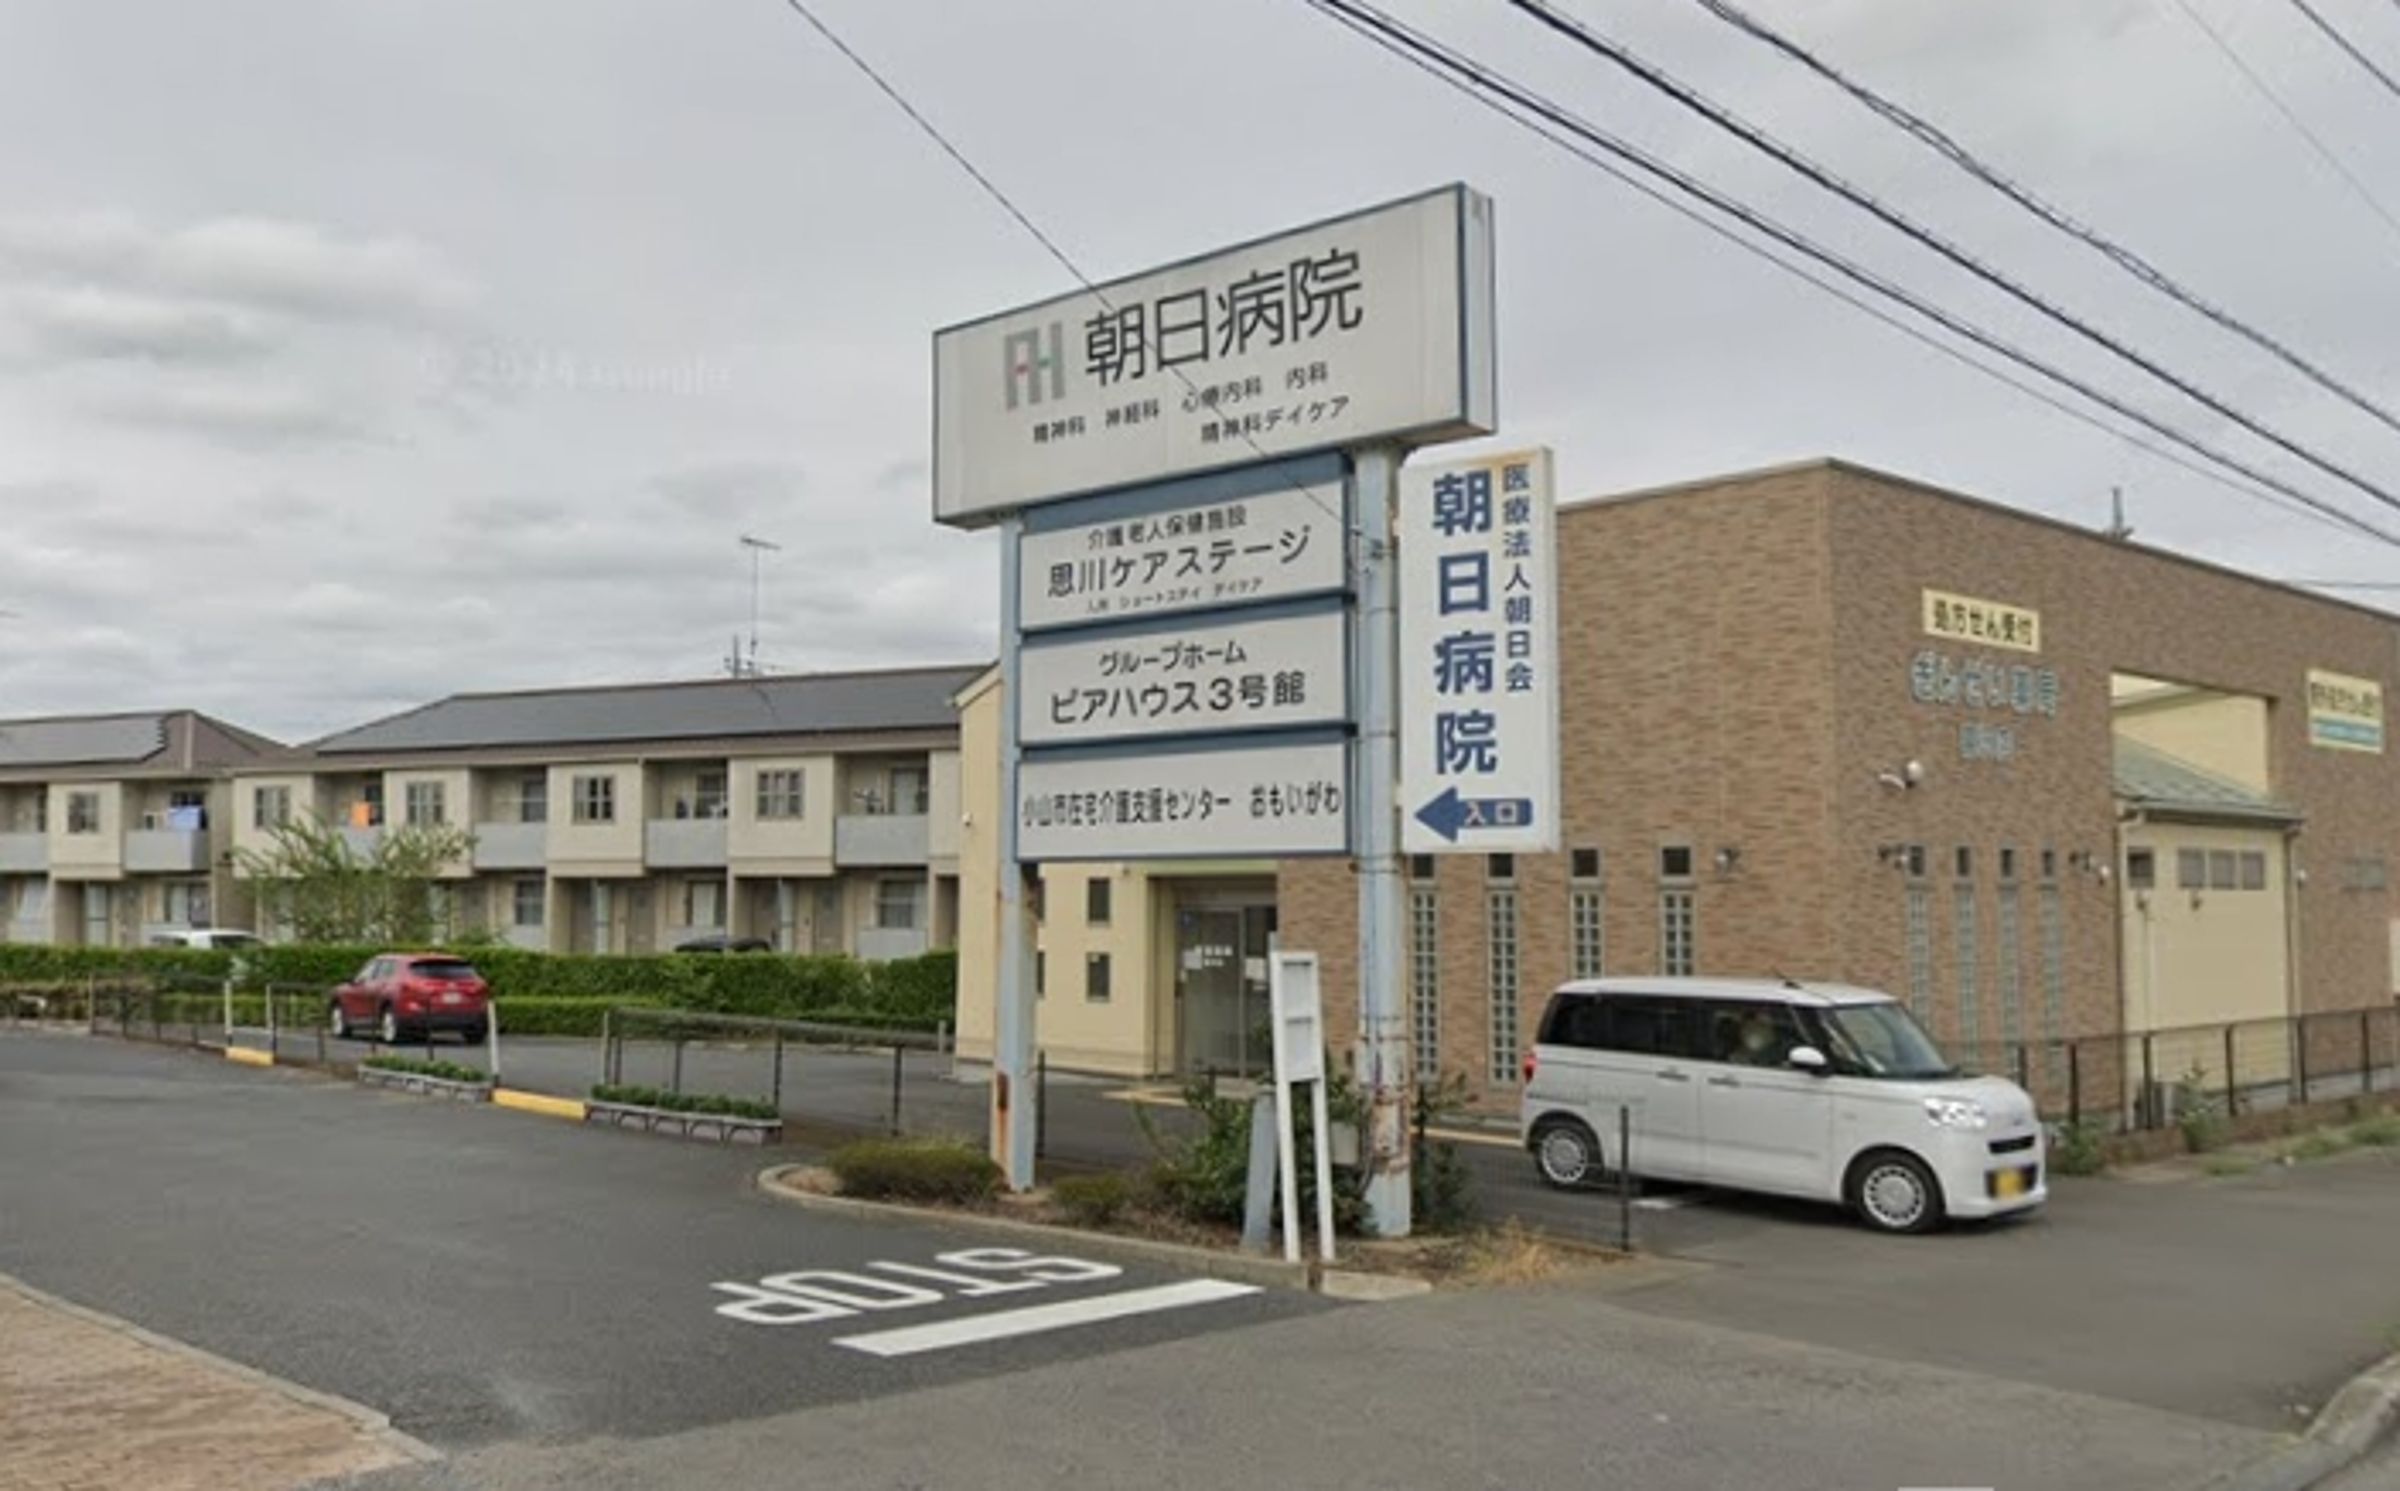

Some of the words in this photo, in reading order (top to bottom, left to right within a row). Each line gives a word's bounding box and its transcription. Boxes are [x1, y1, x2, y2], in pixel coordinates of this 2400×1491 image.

[1084, 247, 1364, 387] 朝日病院
[1286, 360, 1328, 390] 内科
[1088, 504, 1247, 551] 介護老人保健施設
[1047, 524, 1311, 599] 思川ケアステージ
[1502, 463, 1532, 693] 医療法人朝日会
[1432, 468, 1498, 776] 朝日病院
[1099, 639, 1247, 677] グループホーム
[1250, 780, 1343, 820] おもいがわ
[1465, 801, 1519, 826] 入口
[709, 1247, 1123, 1325] STOP
